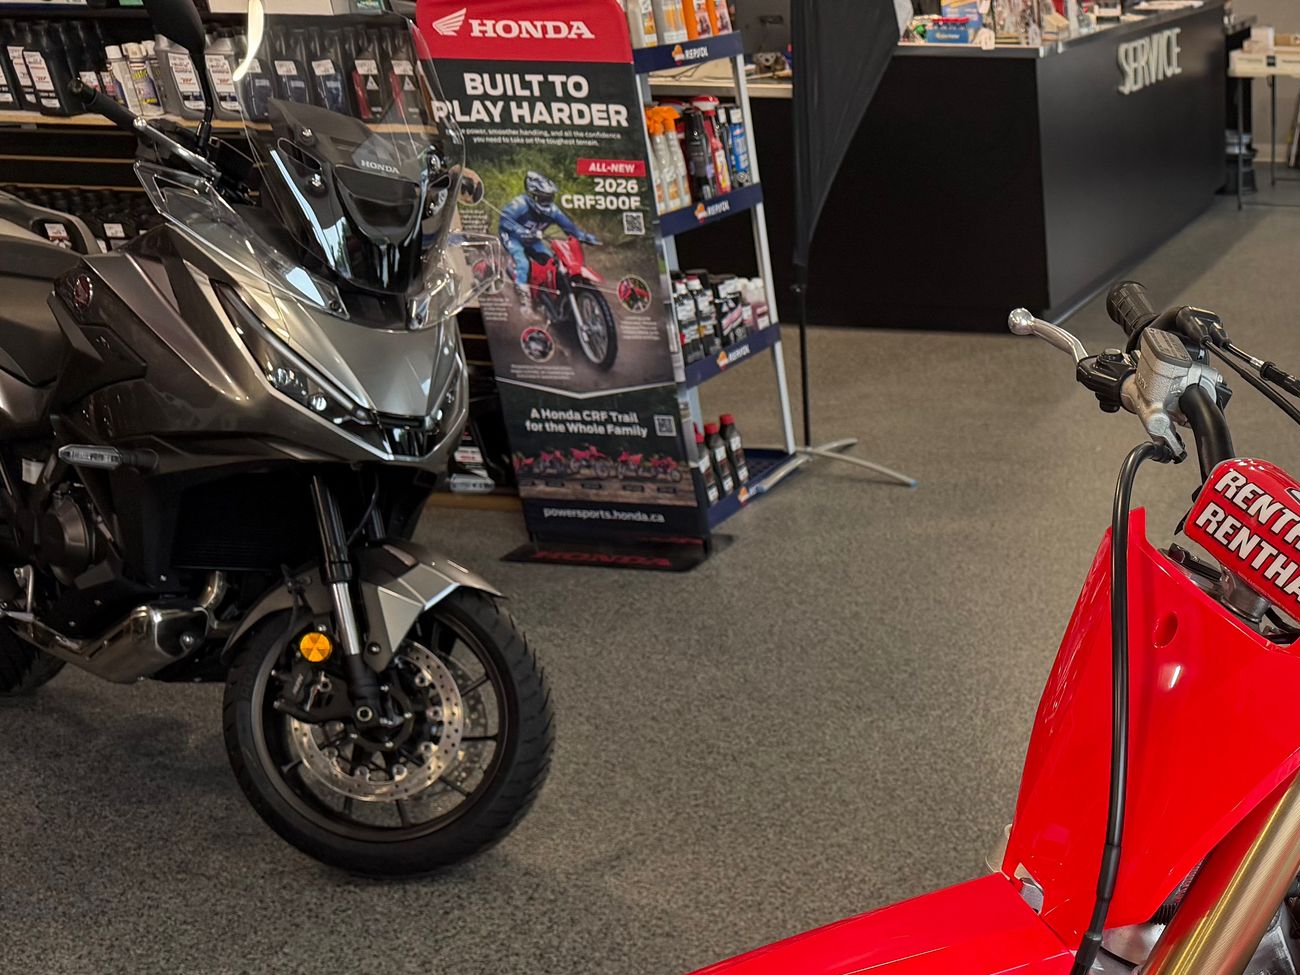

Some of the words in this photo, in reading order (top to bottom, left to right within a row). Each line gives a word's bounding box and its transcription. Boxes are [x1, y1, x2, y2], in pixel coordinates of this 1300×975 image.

[469, 18, 595, 40] HONDA
[1117, 26, 1183, 95] SERVICE
[463, 73, 544, 98] BUILT
[545, 74, 590, 97] TO
[431, 100, 509, 124] PLAY
[511, 102, 629, 128] HARDER
[360, 159, 400, 175] HONDA
[588, 162, 636, 174] ALL-NEW
[593, 178, 639, 194] 2026
[560, 193, 641, 210] CRF300F
[530, 408, 541, 419] A
[541, 409, 581, 421] Honda
[582, 410, 608, 422] CRF
[610, 411, 639, 423] Trail
[525, 420, 544, 432] for
[545, 421, 566, 433] the
[566, 422, 605, 435] Whole
[607, 424, 648, 439] Family
[543, 507, 666, 523] powersports.honda.ca
